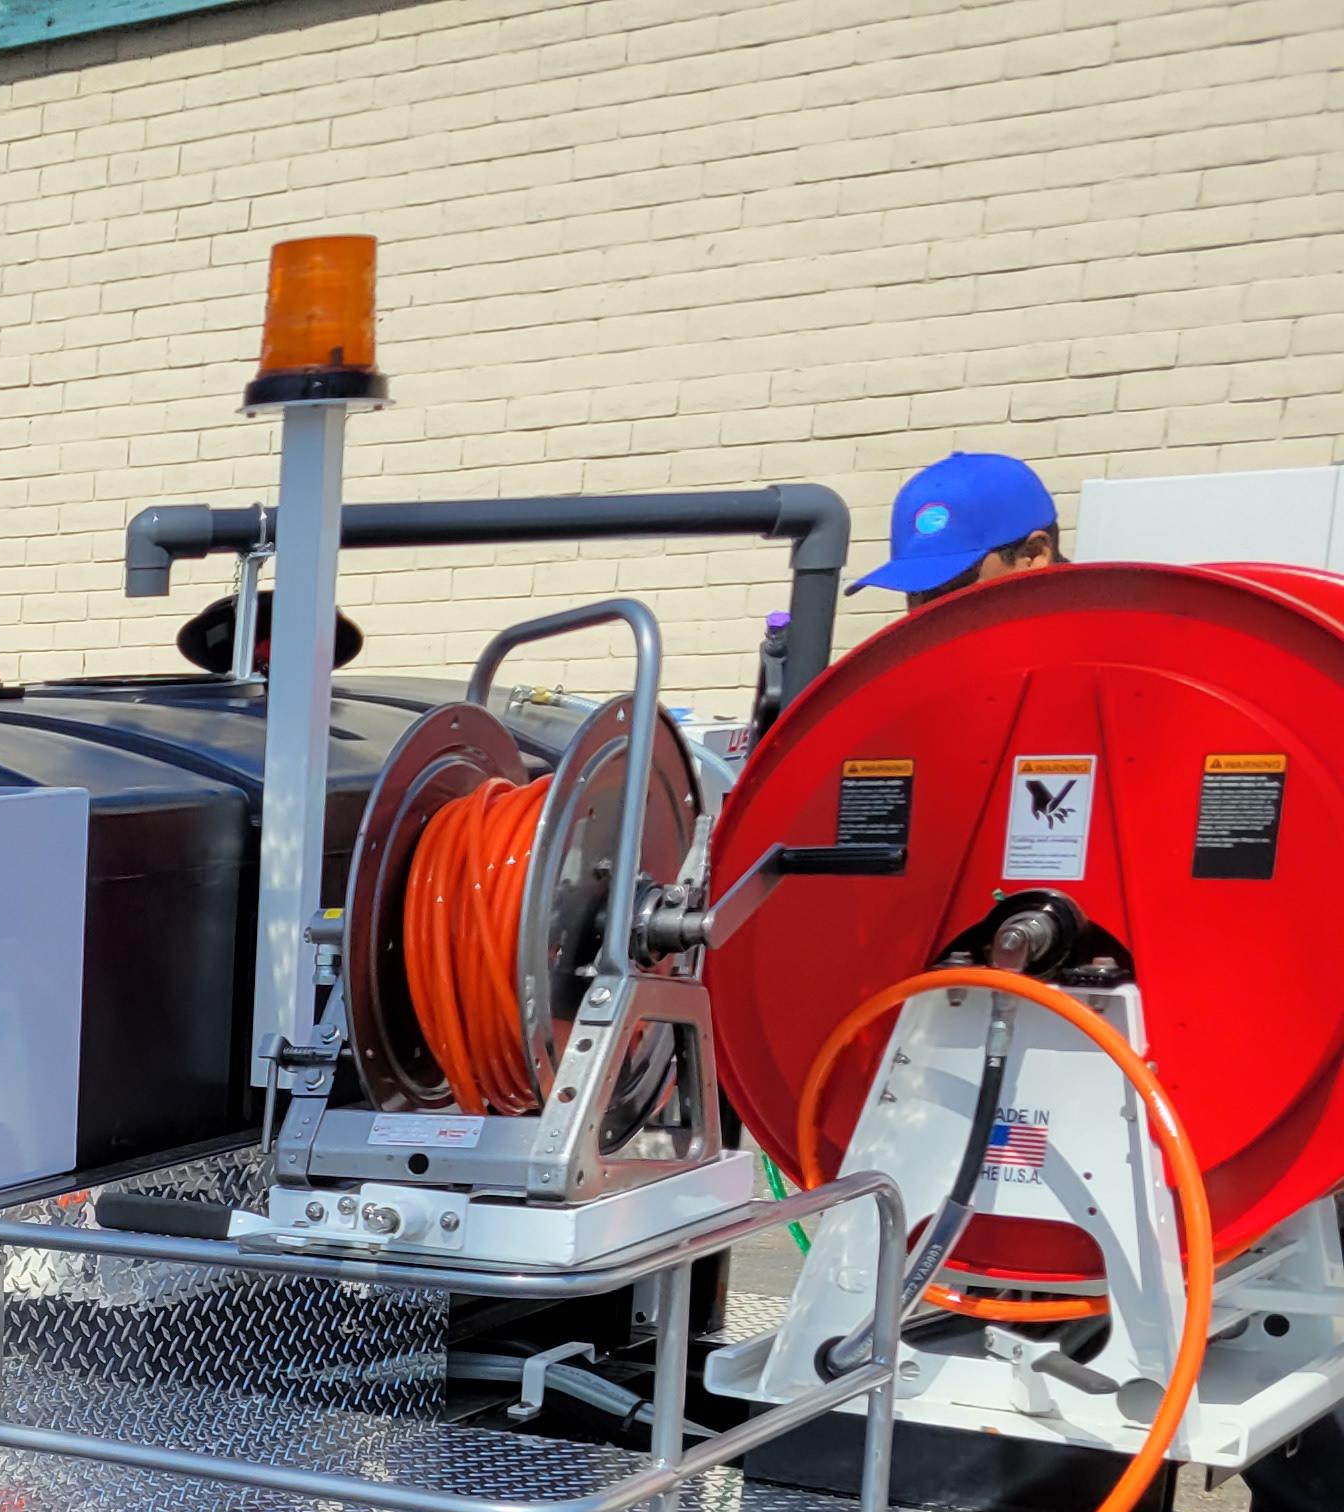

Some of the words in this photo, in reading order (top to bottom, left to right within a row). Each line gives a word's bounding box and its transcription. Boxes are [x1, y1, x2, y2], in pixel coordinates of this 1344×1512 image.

[994, 1107, 1028, 1124] ADE
[1034, 1110, 1050, 1125] IN
[981, 1166, 999, 1181] HE
